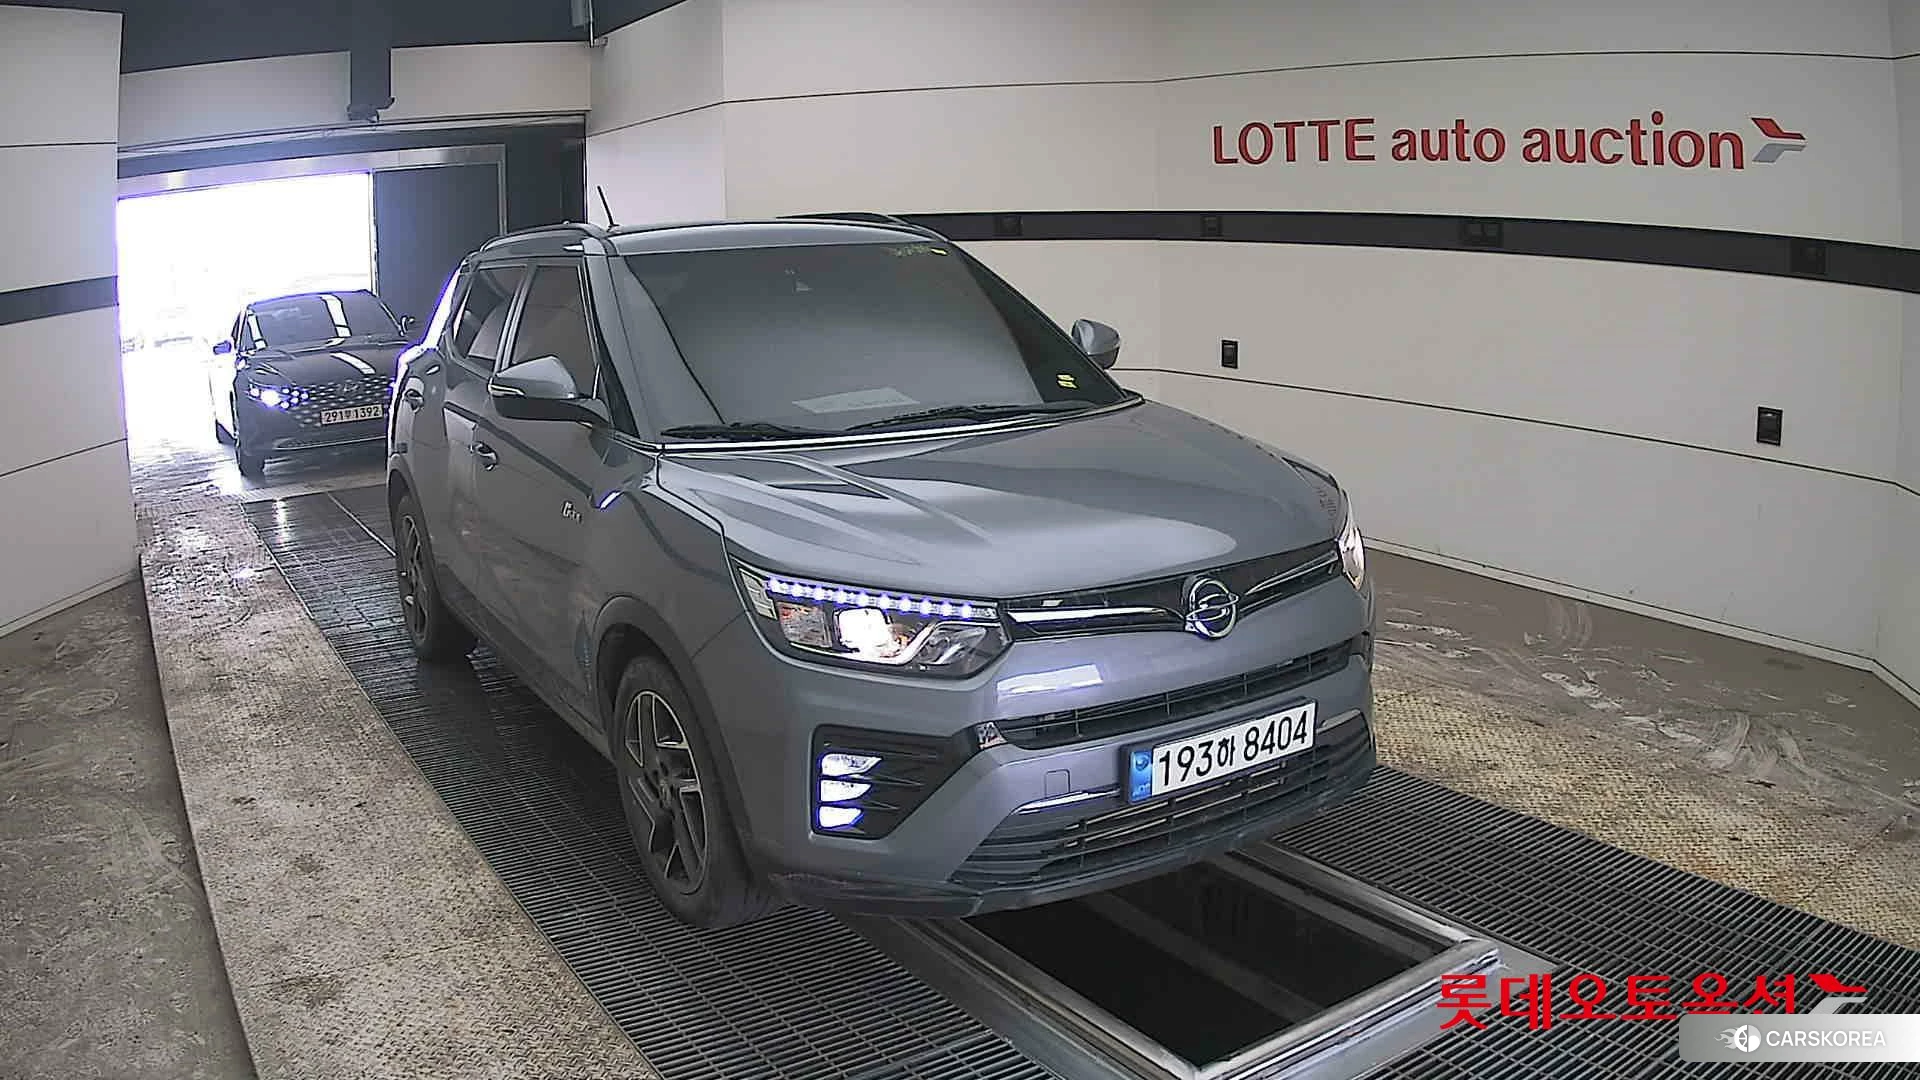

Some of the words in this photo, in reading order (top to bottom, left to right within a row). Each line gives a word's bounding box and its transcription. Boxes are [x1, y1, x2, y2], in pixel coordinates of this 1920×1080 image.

[1213, 118, 1375, 165] LOTTE
[1391, 119, 1506, 162] auto
[1522, 111, 1744, 169] auction
[1159, 736, 1235, 786] 193하
[1243, 711, 1308, 761] 8404
